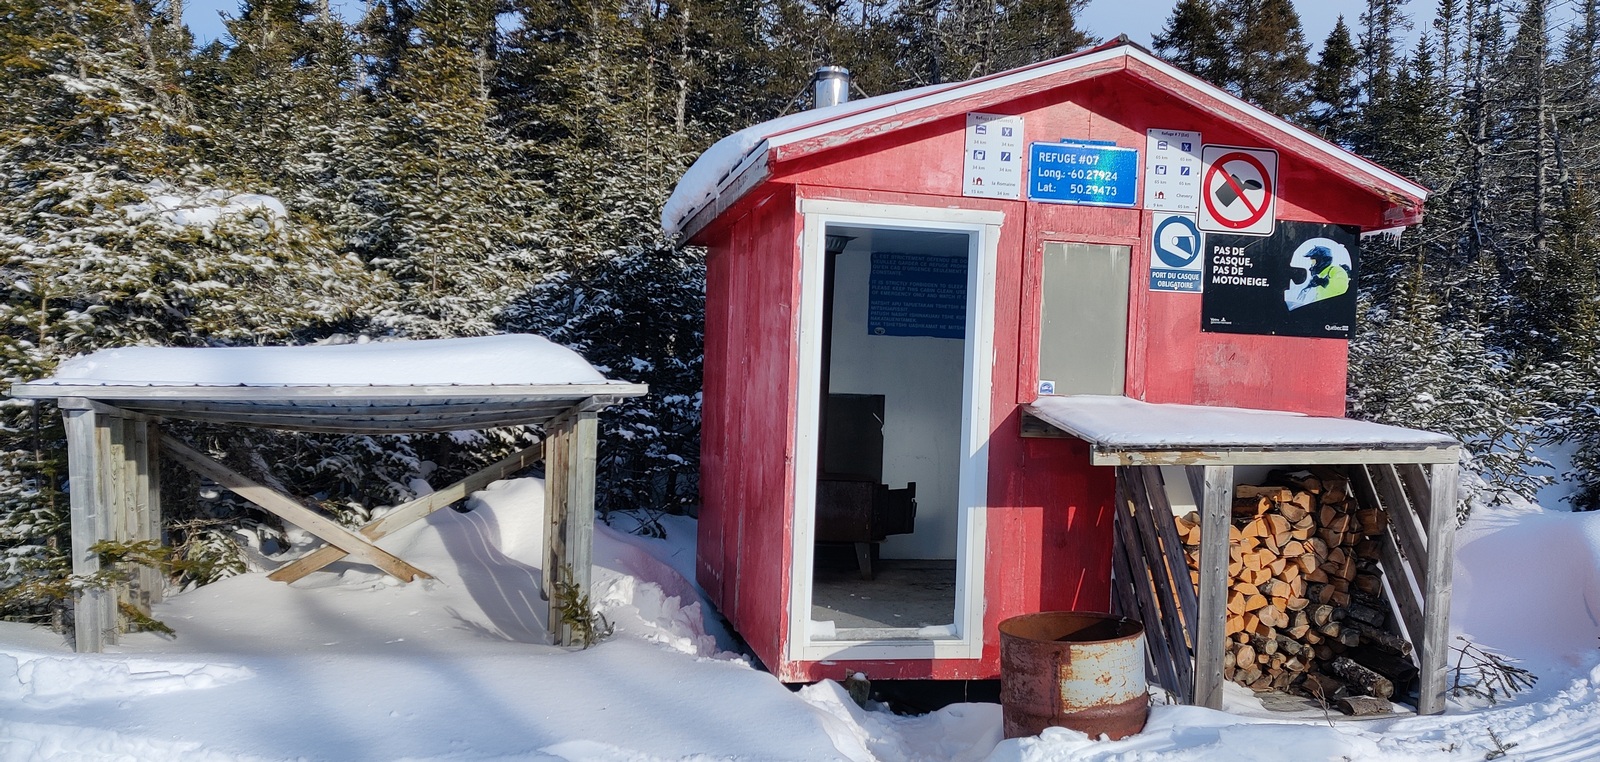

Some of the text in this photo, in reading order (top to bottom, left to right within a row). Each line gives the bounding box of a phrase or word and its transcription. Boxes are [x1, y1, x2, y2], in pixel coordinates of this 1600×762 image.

[1039, 152, 1099, 165] REFUGE #07
[1038, 167, 1118, 181] Long.: -60.27924
[1038, 182, 1117, 196] Lat.: 50.29473
[1214, 246, 1244, 256] PAS DE
[1213, 256, 1253, 268] CASQUE,
[1212, 266, 1243, 276] PAS DE
[1212, 276, 1269, 287] MOTONEIGE.
